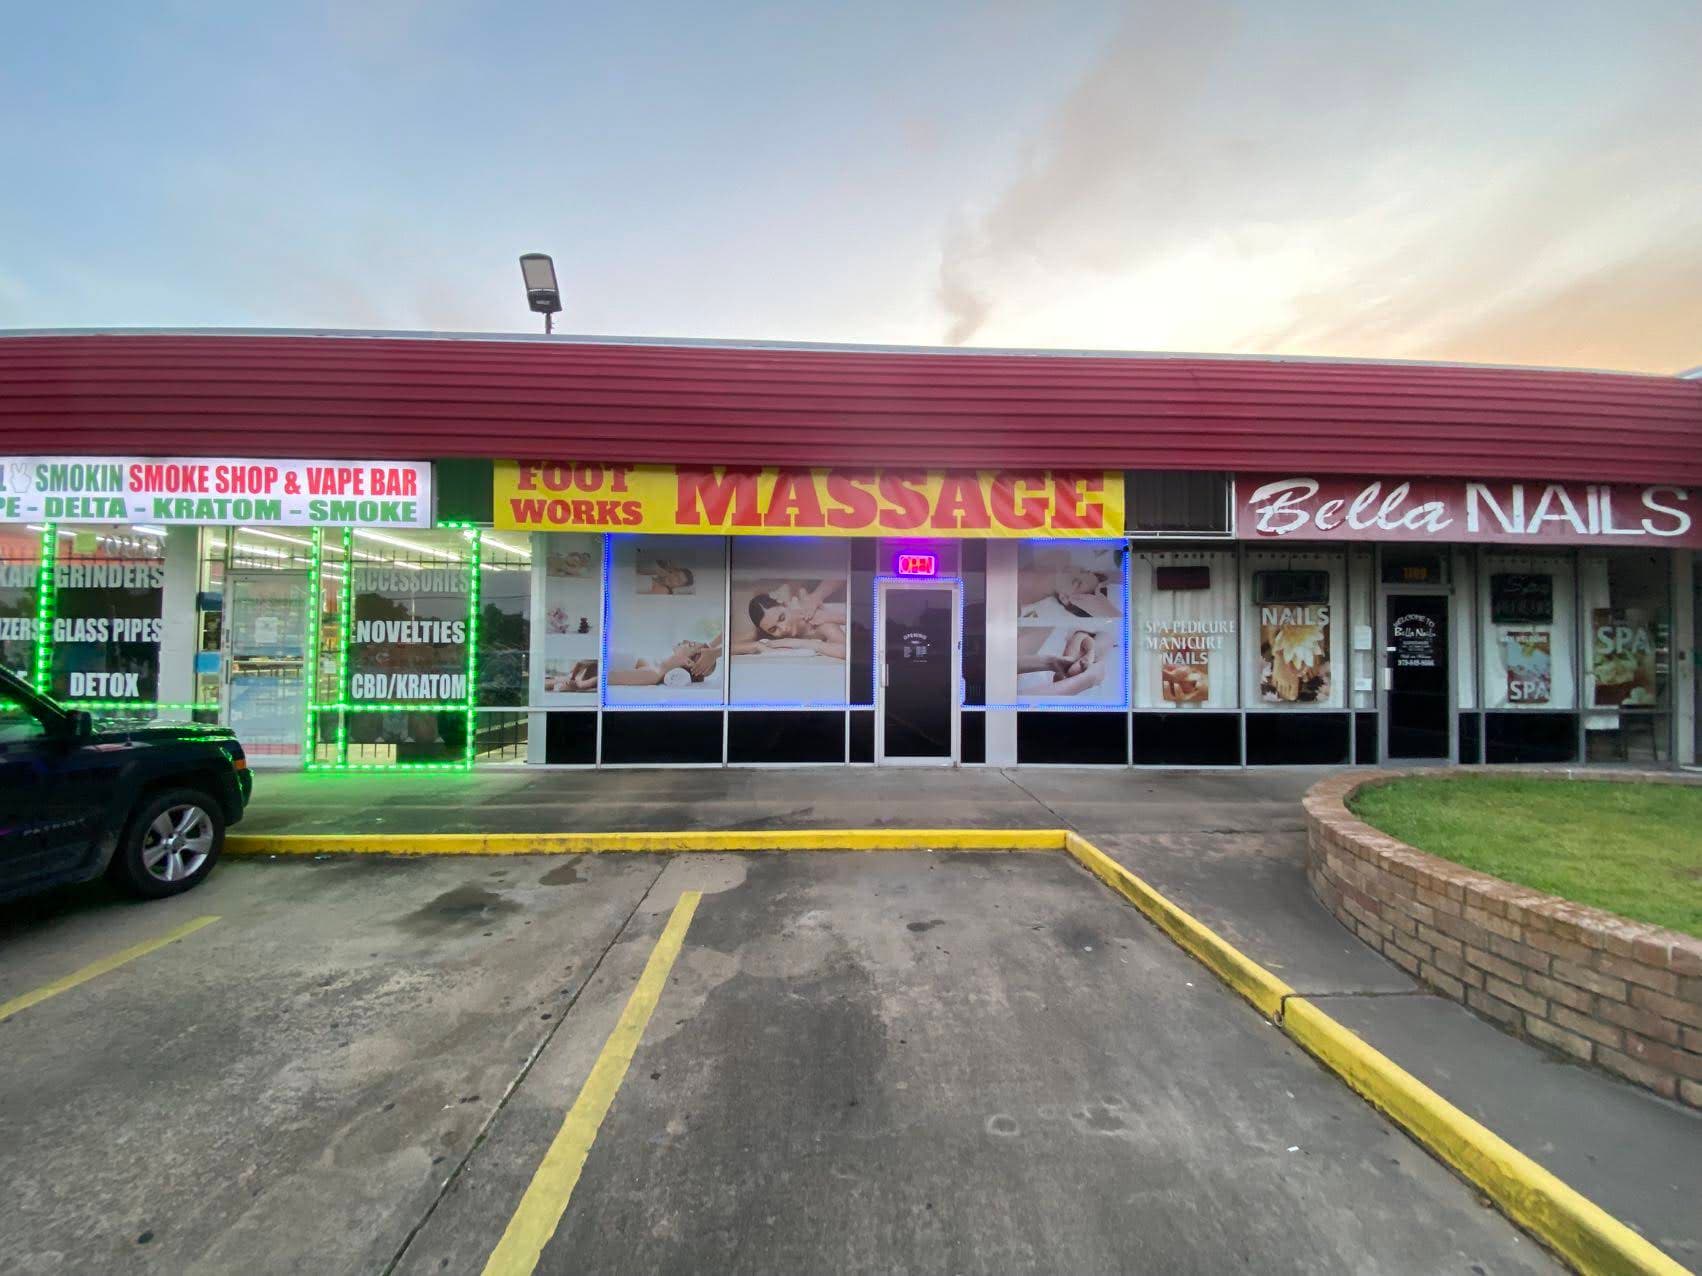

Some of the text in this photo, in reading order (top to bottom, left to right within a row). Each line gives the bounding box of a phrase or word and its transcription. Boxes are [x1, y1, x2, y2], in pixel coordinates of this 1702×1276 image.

[35, 464, 123, 492] SMOKIN
[129, 465, 209, 493] SMOKE
[215, 465, 278, 493] SHOP
[284, 471, 300, 494] &
[306, 467, 364, 495] VAPE
[370, 468, 417, 496] BAR
[518, 460, 1104, 530] FOOT MASSAGE
[1248, 477, 1691, 536] Bella NAILS
[45, 497, 128, 518] DELTA
[153, 499, 281, 520] KRATOM
[309, 500, 417, 522] SMOKE
[510, 499, 643, 525] WORKS
[56, 565, 164, 588] GRINDERS
[355, 571, 469, 593] ACCESSORIES
[1146, 620, 1235, 633] SPA PEDICURE
[1262, 607, 1329, 627] NAILS
[54, 618, 162, 642] GLASS PIPES
[356, 621, 466, 644] NOVELTIES
[1597, 626, 1650, 654] SPA
[1162, 652, 1208, 665] NAILS
[70, 672, 139, 697] DETOX
[351, 674, 467, 699] CBD/KRATOM
[1510, 681, 1550, 700] SPA
